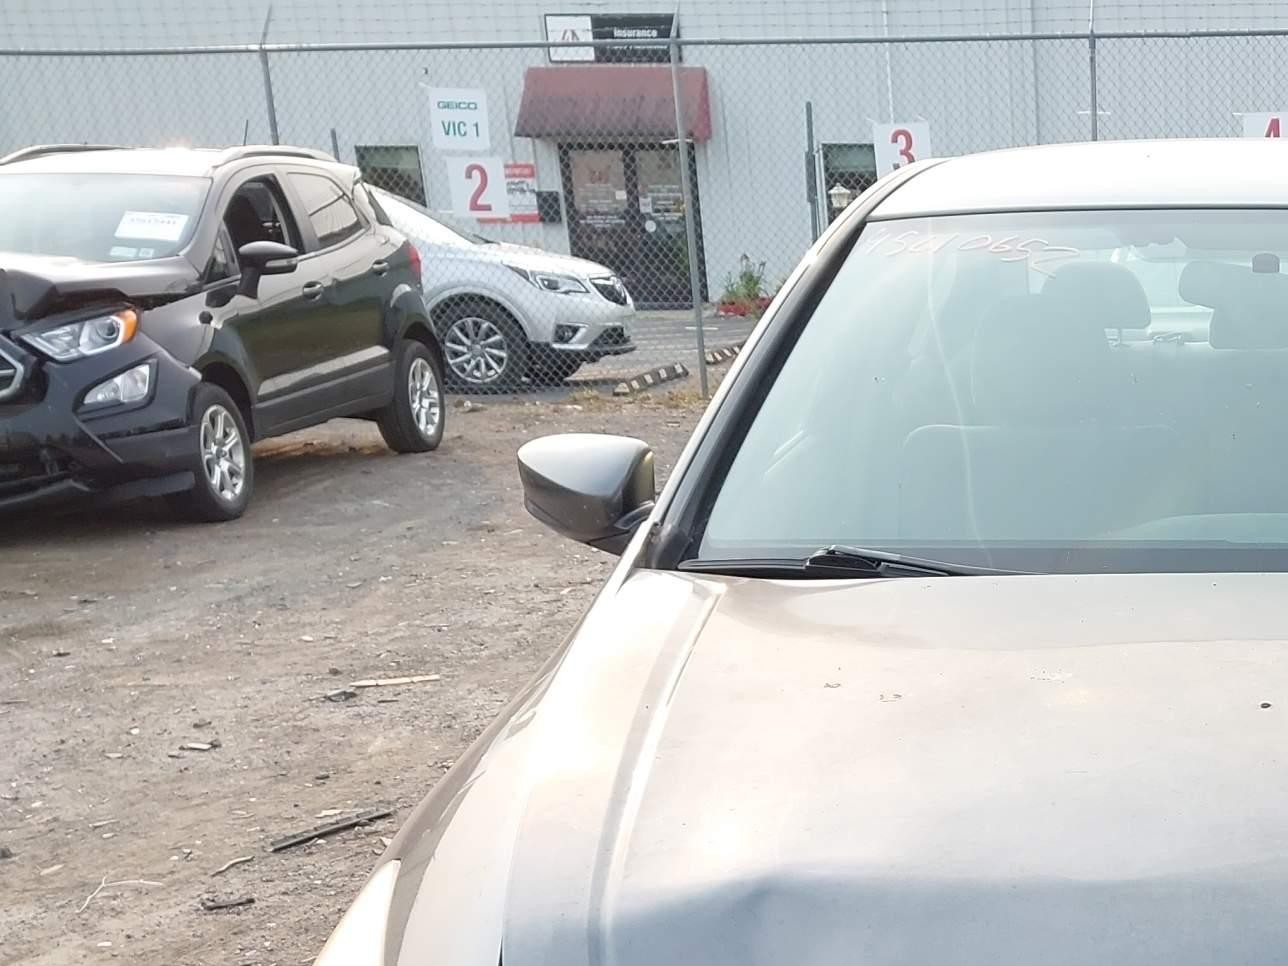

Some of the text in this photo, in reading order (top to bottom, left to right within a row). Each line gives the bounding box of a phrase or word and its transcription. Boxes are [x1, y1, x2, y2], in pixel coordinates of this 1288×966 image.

[437, 101, 478, 110] GEICO
[441, 120, 480, 138] VIC 1
[891, 129, 915, 170] 3
[464, 163, 492, 212] 2
